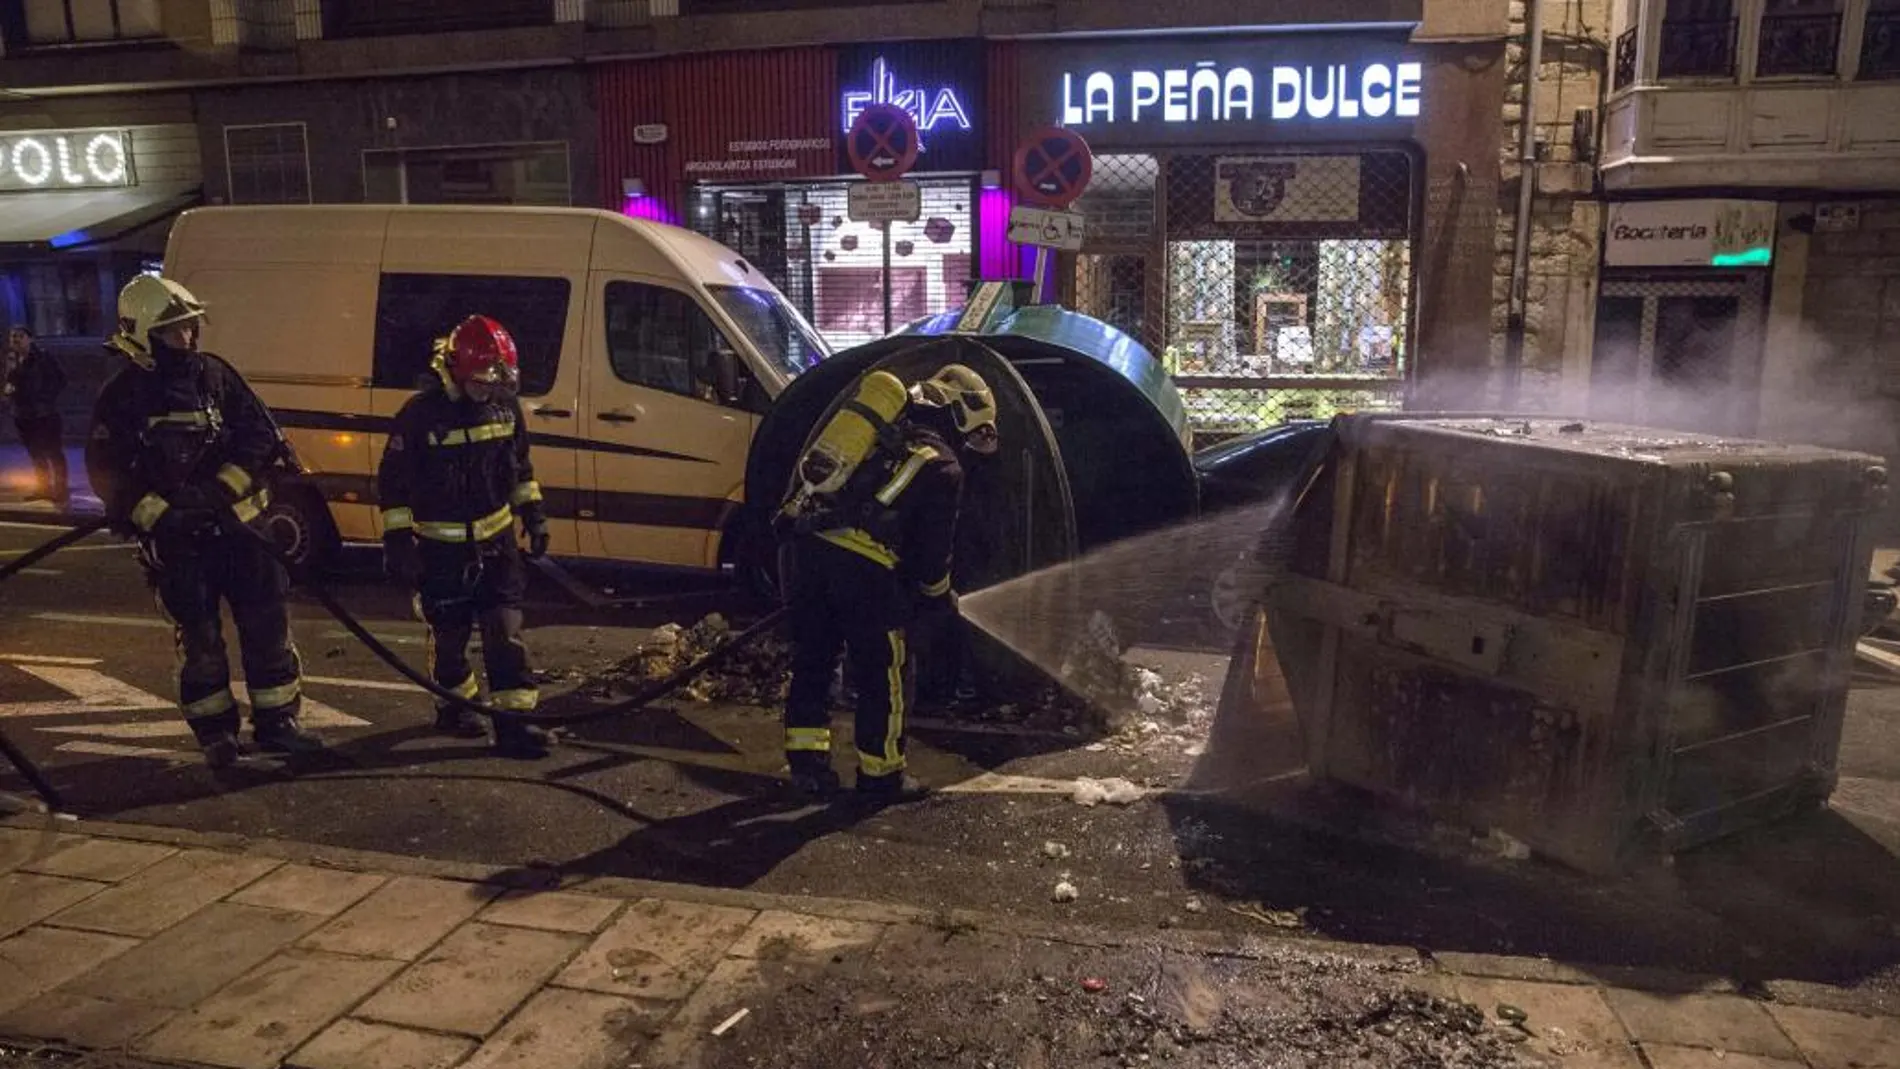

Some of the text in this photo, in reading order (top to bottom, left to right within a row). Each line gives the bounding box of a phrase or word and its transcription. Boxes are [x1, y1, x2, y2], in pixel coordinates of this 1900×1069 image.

[1064, 61, 1421, 124] LA PEÑA DULCE
[0, 134, 125, 184] OLO
